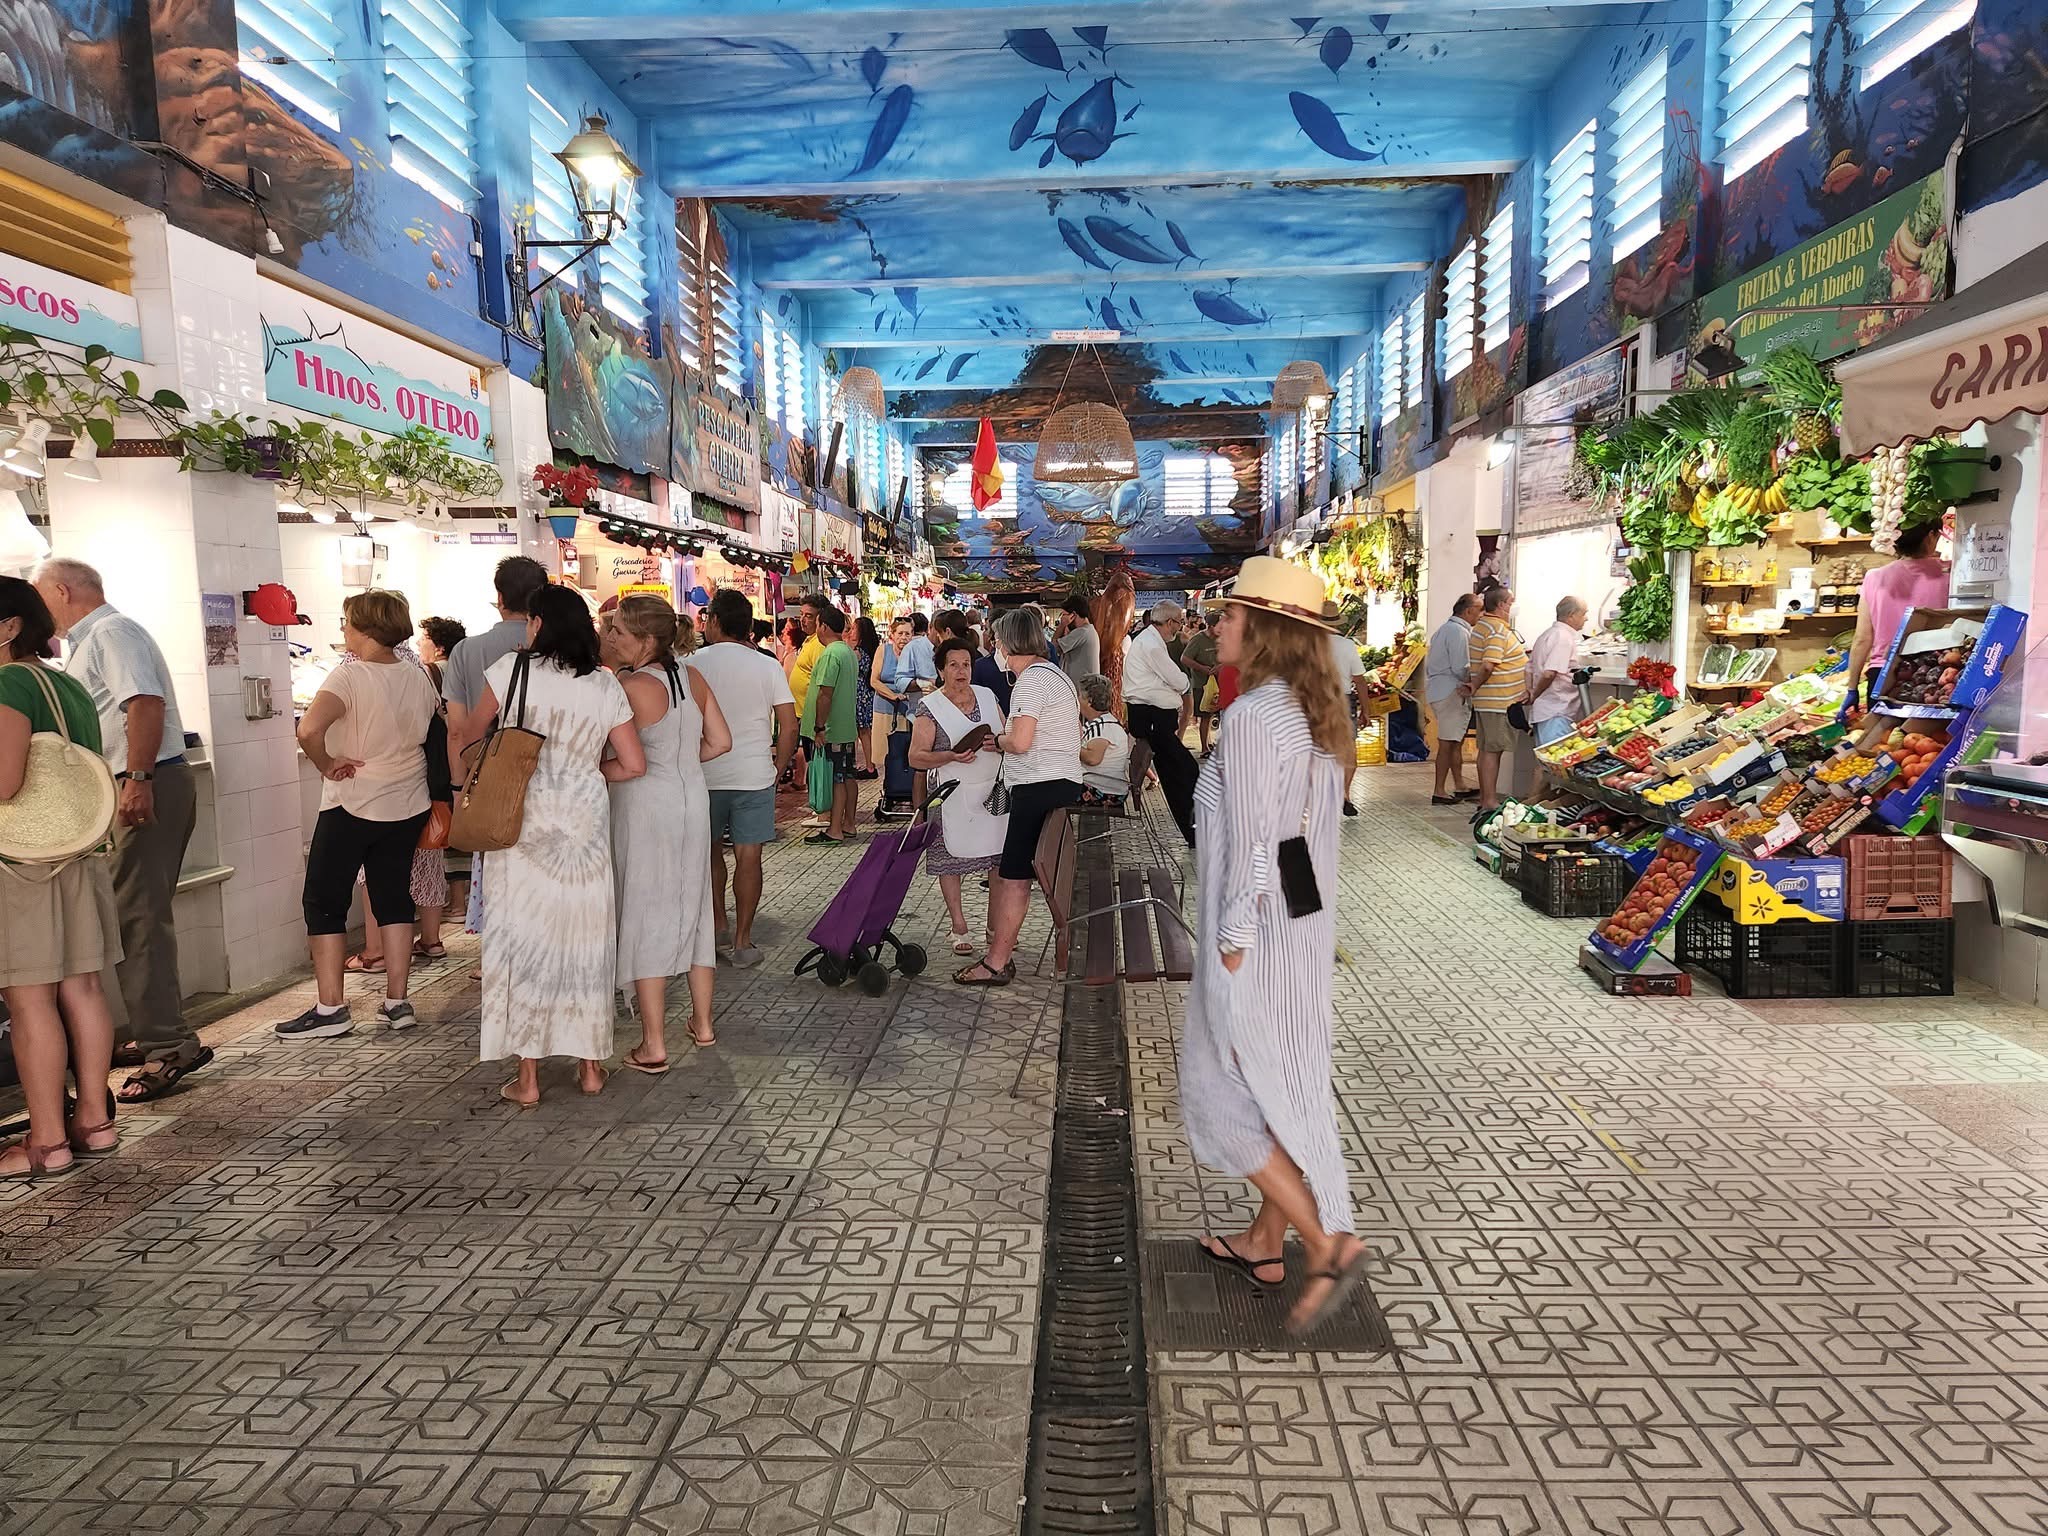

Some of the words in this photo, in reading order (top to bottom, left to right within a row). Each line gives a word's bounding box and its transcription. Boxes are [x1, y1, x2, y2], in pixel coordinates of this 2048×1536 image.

[1737, 266, 1782, 311] FRUTAS
[1784, 258, 1797, 289] &
[1800, 216, 1875, 281] VERDURAS
[1798, 283, 1818, 308] del
[1820, 265, 1865, 304] Abuelo
[294, 349, 388, 414] Hnos.
[395, 385, 481, 441] OTERO
[708, 440, 748, 487] GUERRA
[611, 567, 638, 580] Guerra
